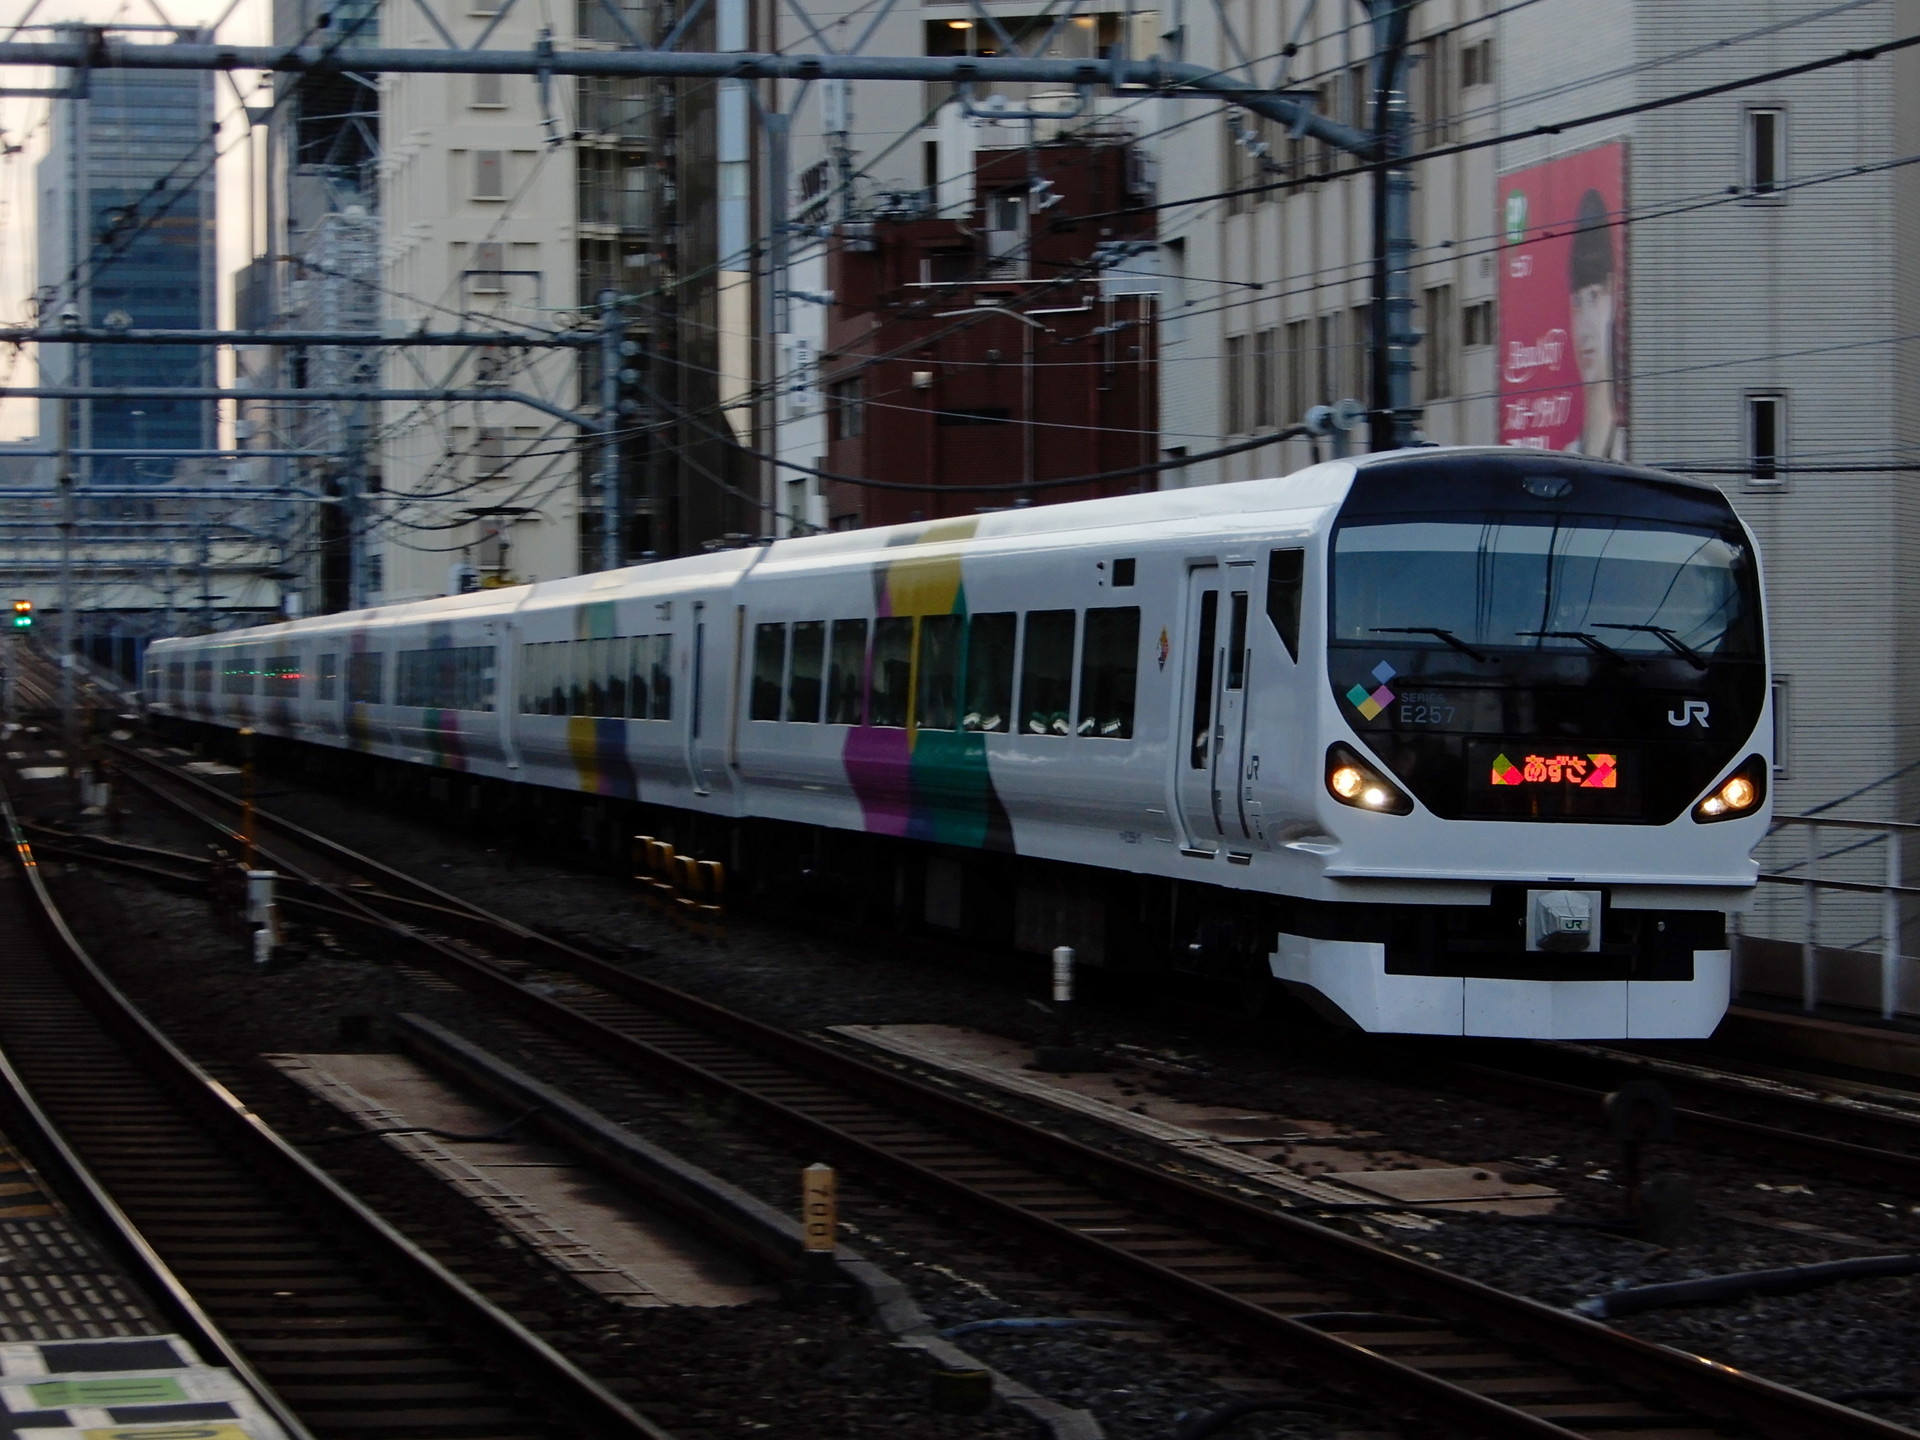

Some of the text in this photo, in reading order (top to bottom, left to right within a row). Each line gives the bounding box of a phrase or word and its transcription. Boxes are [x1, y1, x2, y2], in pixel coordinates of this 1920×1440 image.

[1401, 705, 1456, 724] E257
[1668, 700, 1710, 728] JR
[1246, 755, 1260, 781] JR
[1524, 754, 1587, 784] あずさ
[1565, 919, 1582, 930] JR
